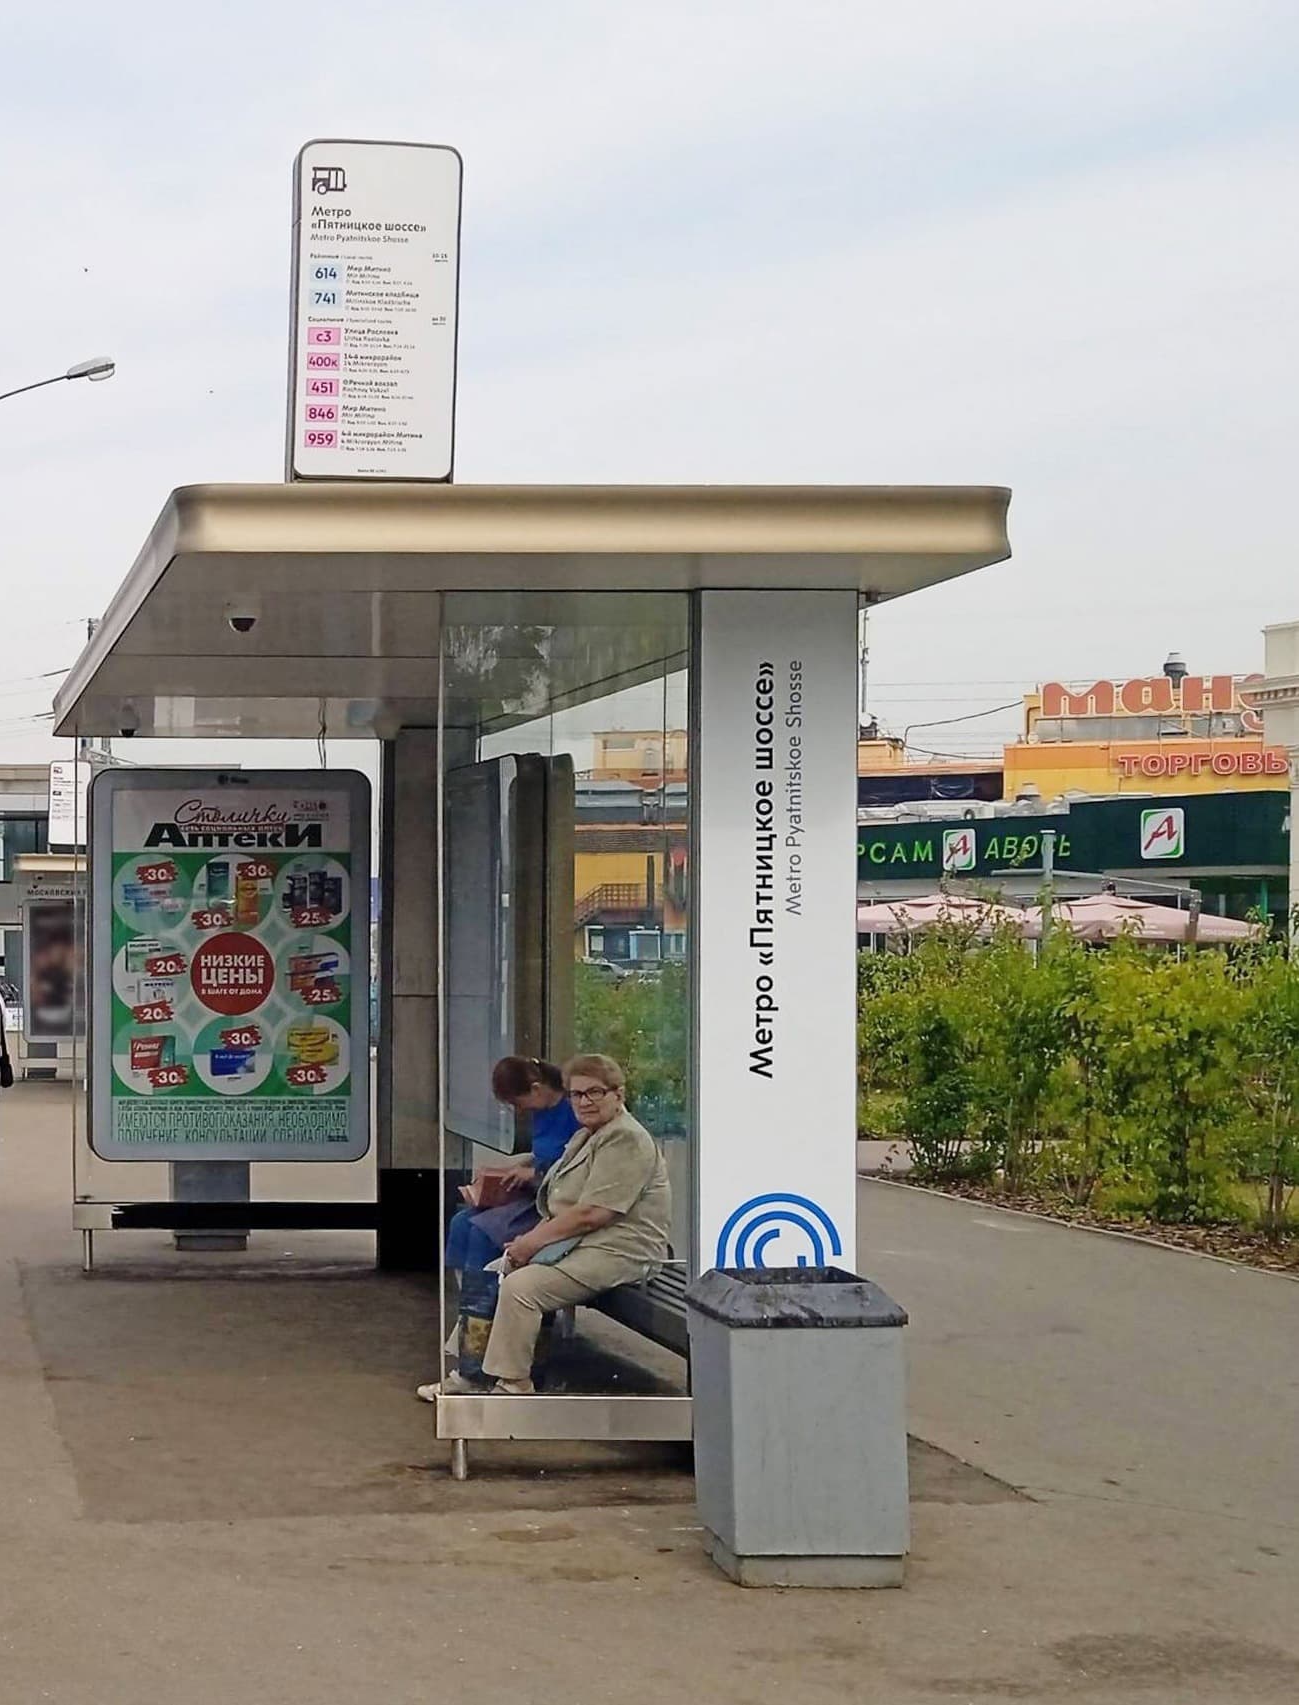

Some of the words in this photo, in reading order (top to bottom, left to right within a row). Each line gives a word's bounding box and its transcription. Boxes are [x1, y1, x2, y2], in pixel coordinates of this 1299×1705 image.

[311, 206, 352, 219] Метро
[311, 219, 382, 232] «Пятницкое
[384, 221, 427, 233] шоссе»
[310, 233, 335, 242] Metro
[336, 234, 380, 244] Pyatnitskoe
[382, 235, 409, 243] Shosse
[314, 267, 337, 280] 614
[314, 292, 336, 304] 741
[316, 331, 332, 343] с3
[309, 356, 338, 367] 400к
[311, 382, 333, 393] 451
[308, 408, 334, 419] 846
[308, 433, 333, 445] 959
[784, 660, 802, 728] Shosse
[755, 661, 774, 770] шоссе»
[784, 735, 805, 847] Pyatnitskoe
[173, 799, 290, 824] Столички
[749, 780, 777, 966] «Пятницкое
[785, 854, 802, 916] Metro
[200, 954, 265, 967] НИЗКИЕ
[201, 967, 264, 987] ЦЕНЫ
[239, 988, 263, 996] ДОМА
[749, 975, 779, 1079] Метро
[117, 1111, 167, 1129] ИМЕЮТСЯ
[279, 1111, 347, 1130] НЕОБХОДИМО
[117, 1128, 179, 1142] ПОЛУЧЕНИЕ
[185, 1128, 266, 1142] КОНСУЛЬТАЦИИ
